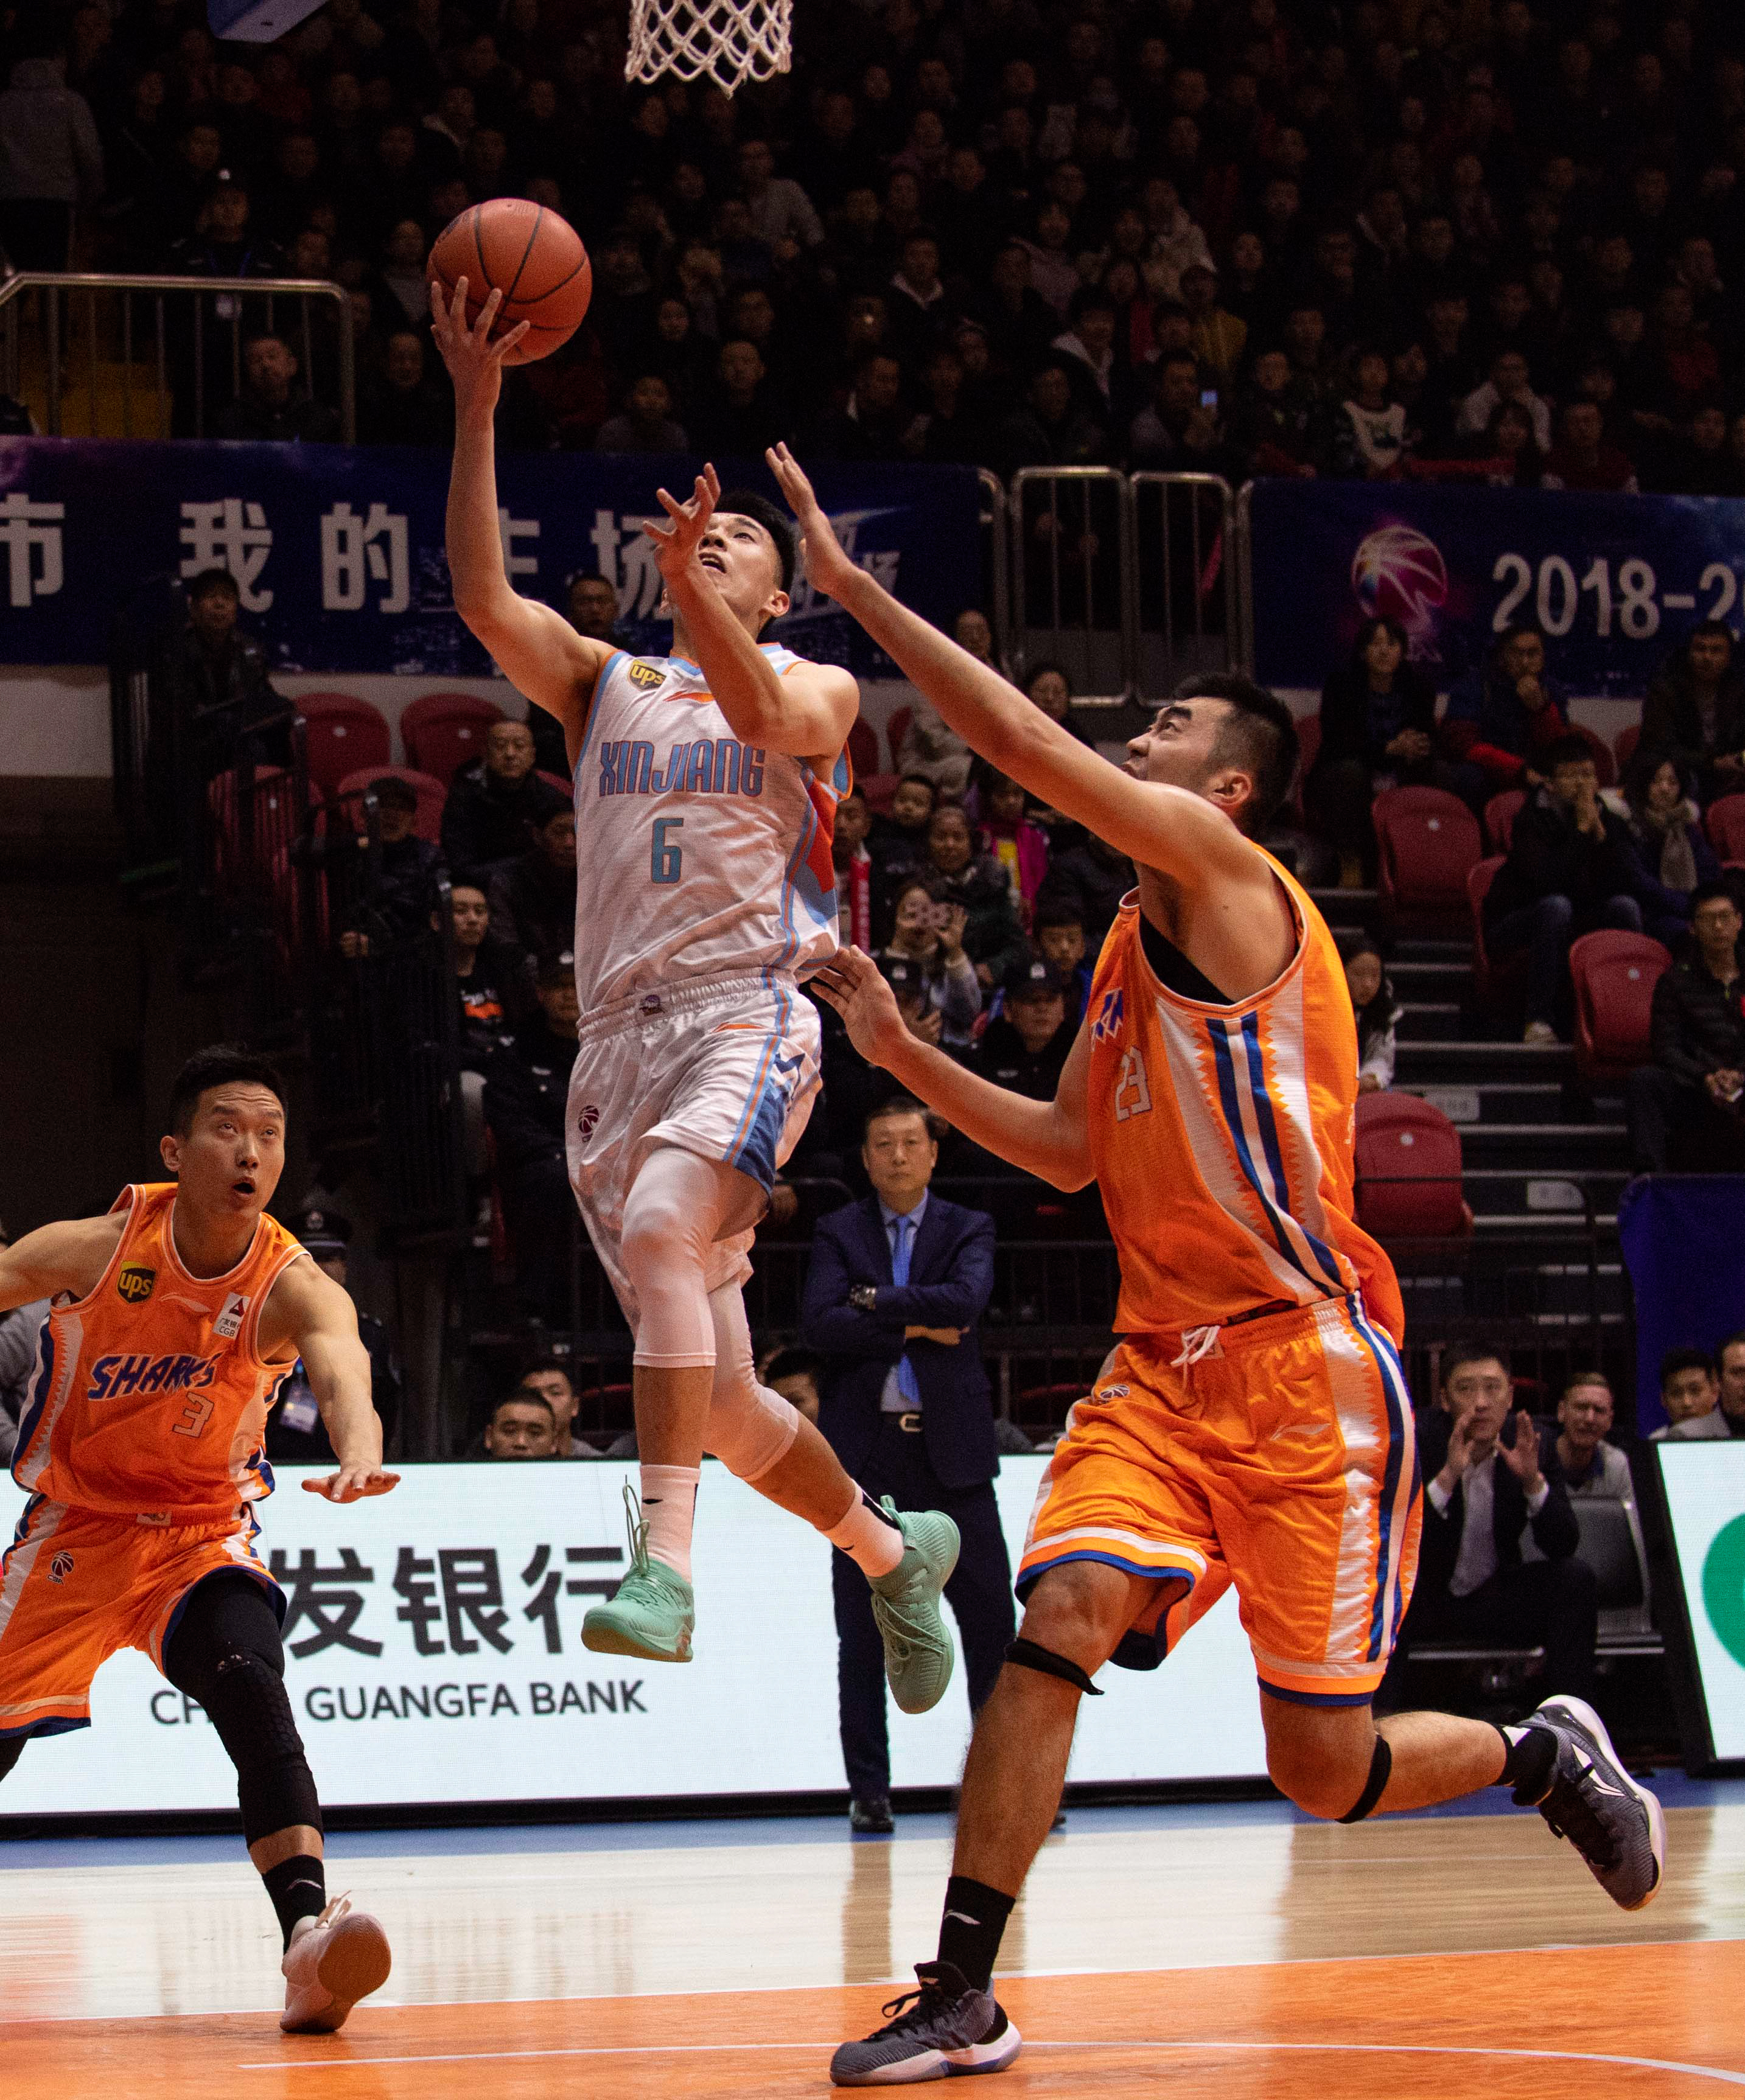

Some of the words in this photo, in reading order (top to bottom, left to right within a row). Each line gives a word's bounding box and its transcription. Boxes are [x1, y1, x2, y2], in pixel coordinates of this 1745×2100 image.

[631, 665, 663, 686] ups
[599, 738, 766, 797] XINJIANG
[651, 817, 684, 884] 6
[1114, 1045, 1152, 1123] 23
[119, 1272, 152, 1299] ups
[219, 1326, 235, 1337] CGB
[87, 1349, 228, 1401] SHARKS
[172, 1391, 214, 1438] 3
[305, 1683, 519, 1721] GUANGFA
[530, 1680, 648, 1714] BANK
